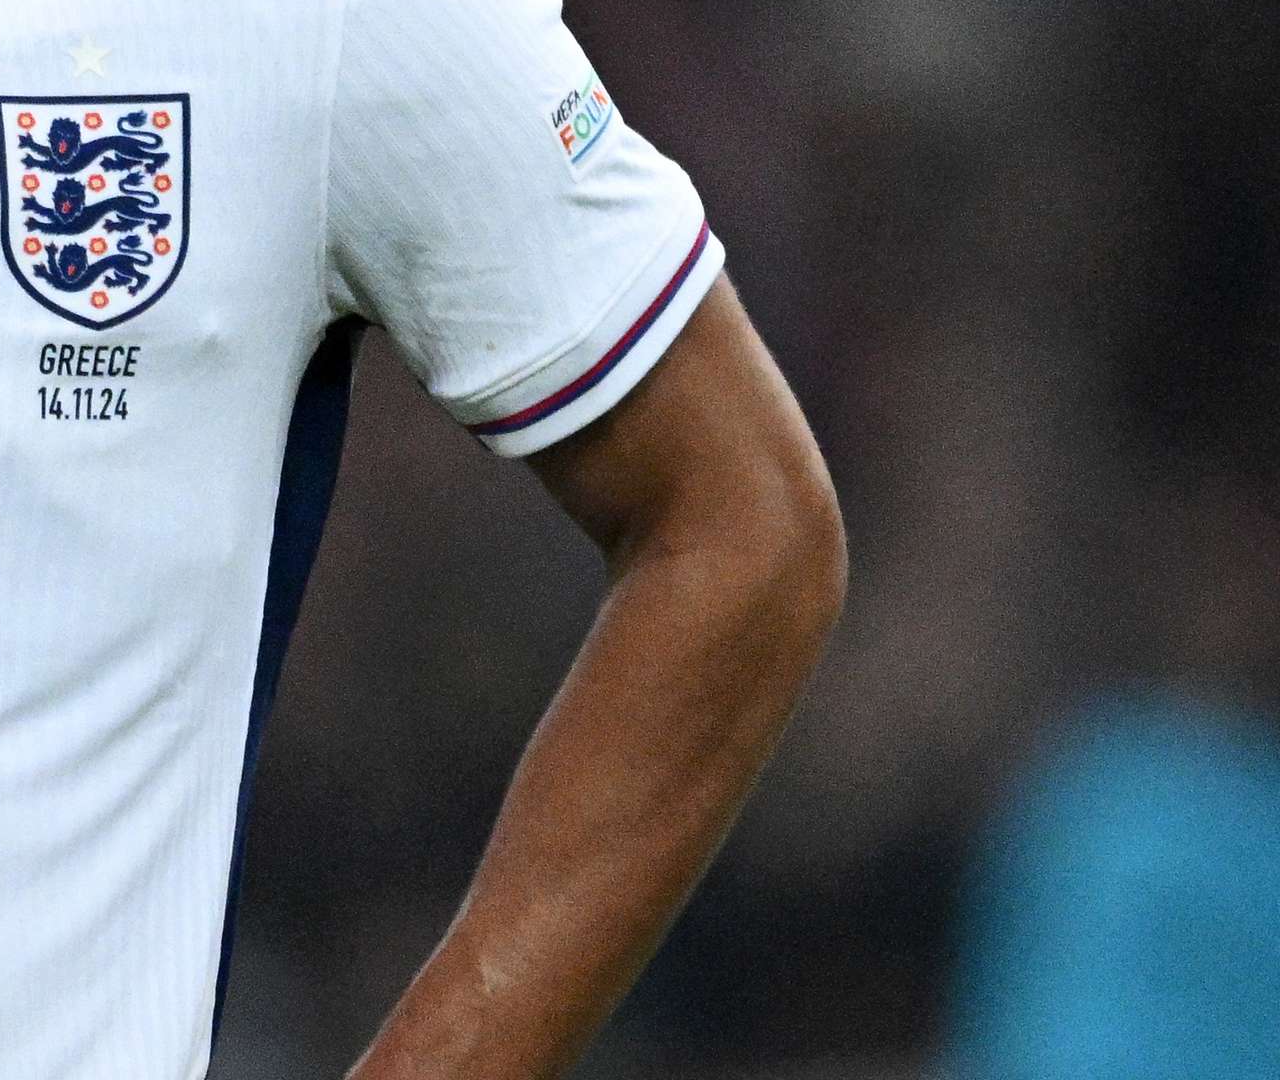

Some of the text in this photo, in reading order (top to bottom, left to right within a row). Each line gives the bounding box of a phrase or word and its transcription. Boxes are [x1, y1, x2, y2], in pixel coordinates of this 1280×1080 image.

[551, 89, 582, 128] UEFA
[39, 343, 141, 377] GREECE
[38, 386, 128, 420] 14.11.24
